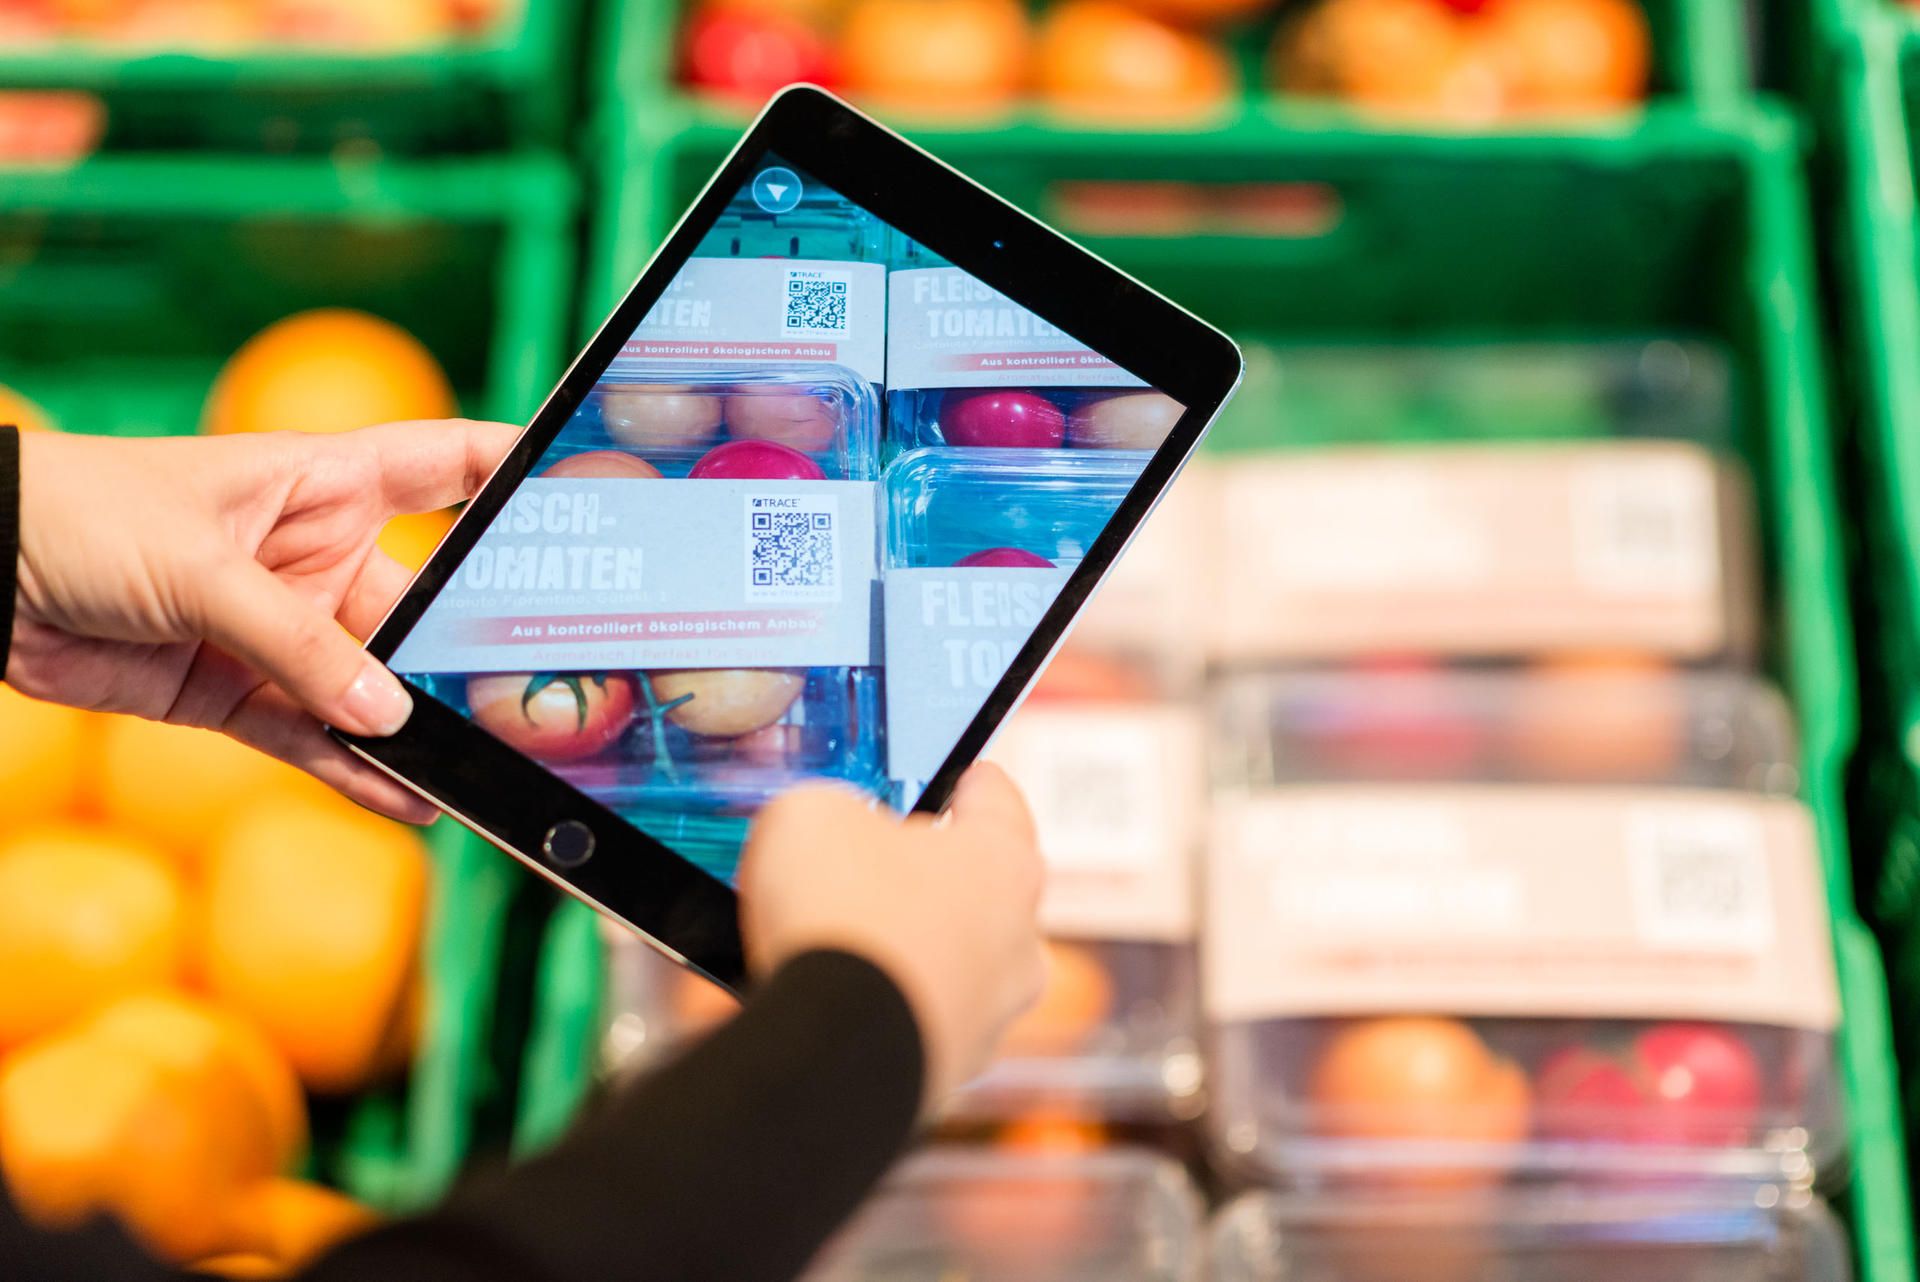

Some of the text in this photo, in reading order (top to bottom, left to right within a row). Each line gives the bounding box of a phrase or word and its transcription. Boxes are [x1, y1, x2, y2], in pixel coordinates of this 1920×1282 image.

[914, 275, 1008, 304] FLEIS
[645, 345, 709, 354] kontrolliert
[713, 346, 791, 356] ökologischem
[795, 347, 831, 356] Anbau
[980, 358, 1002, 366] Aus
[1006, 356, 1076, 366] kontrolliert
[488, 491, 617, 534] ISCH-
[511, 616, 817, 637] Aus kontrolliert ökologischem Anbau
